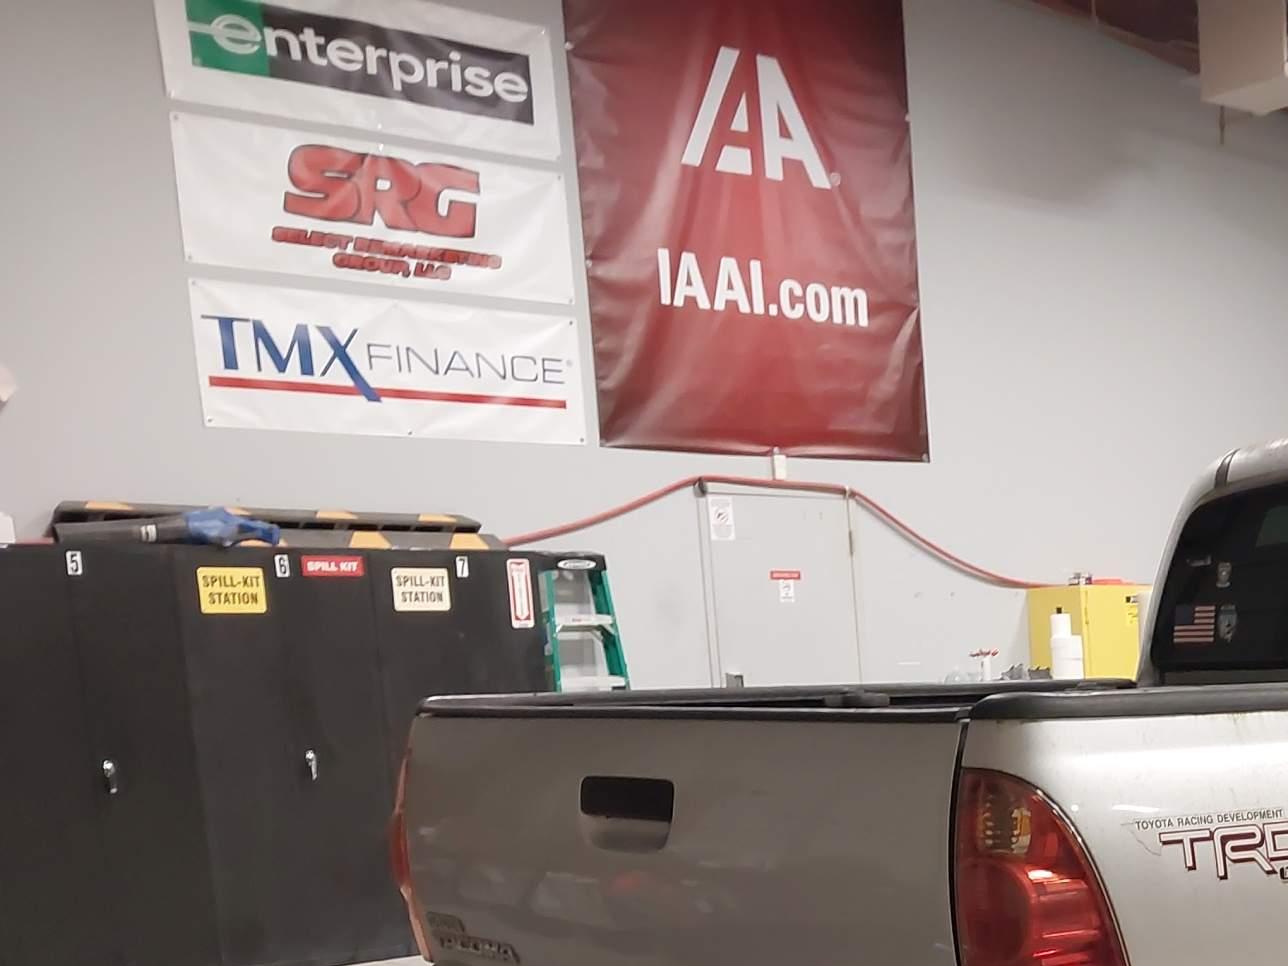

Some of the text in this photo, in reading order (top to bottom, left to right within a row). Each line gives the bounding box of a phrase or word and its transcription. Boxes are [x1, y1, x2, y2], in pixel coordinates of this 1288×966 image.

[208, 14, 528, 103] enterprise
[284, 144, 480, 238] SRG
[658, 247, 869, 328] IAAI.com
[201, 314, 565, 403] TMX FINANCE
[70, 552, 79, 573] 5
[277, 556, 287, 575] 6
[307, 561, 359, 572] SPILL KIT
[459, 558, 466, 577] 7
[202, 575, 260, 588] SPILL-KIT
[396, 575, 445, 587] SPILL-KIT
[208, 592, 259, 605] STATION
[401, 591, 443, 603] STATION
[1135, 808, 1284, 831] TOYOTA RACING DEVELOPMENT
